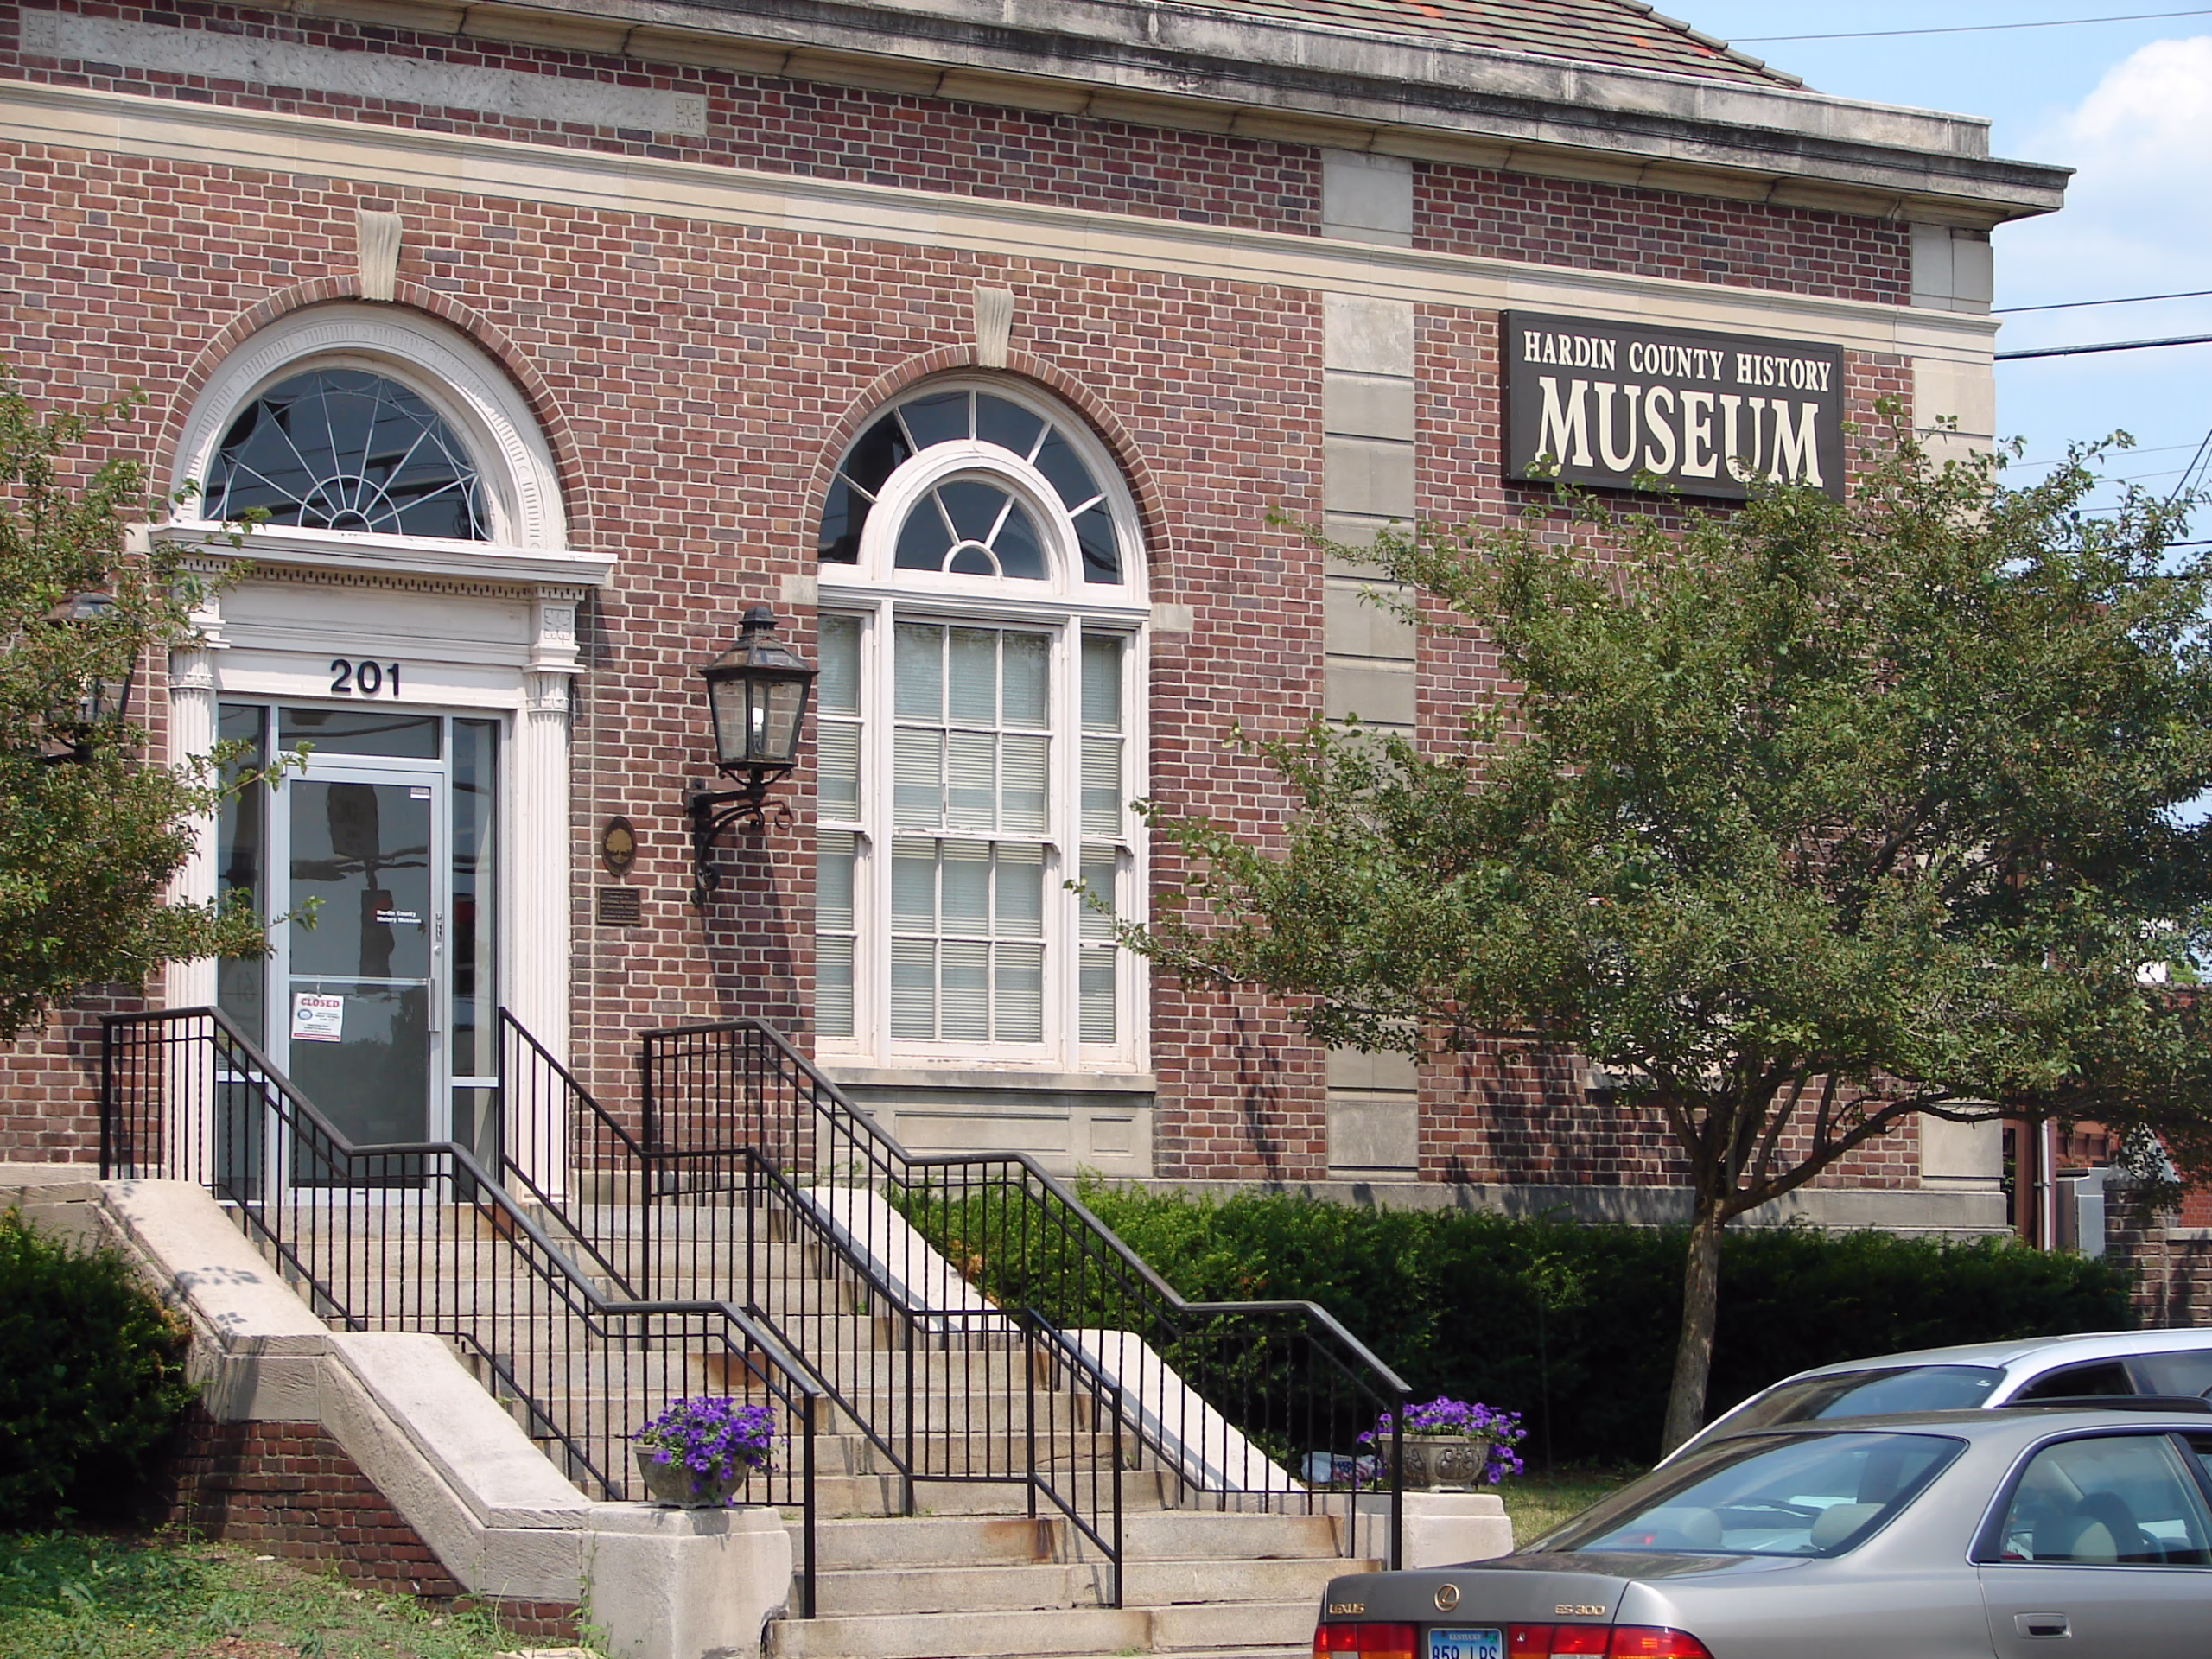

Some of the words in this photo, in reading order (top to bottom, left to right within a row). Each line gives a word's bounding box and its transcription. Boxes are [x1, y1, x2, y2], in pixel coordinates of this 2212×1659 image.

[1523, 330, 1616, 371] HARDIN
[1629, 341, 1725, 381] COUNTY
[1736, 353, 1832, 392] HISTORY
[1535, 376, 1824, 488] MUSEUM
[330, 658, 400, 696] 201
[301, 998, 340, 1007] CLOSED
[1329, 1604, 1365, 1614] LEXUS
[1555, 1605, 1573, 1614] ES
[1575, 1605, 1605, 1616] 300
